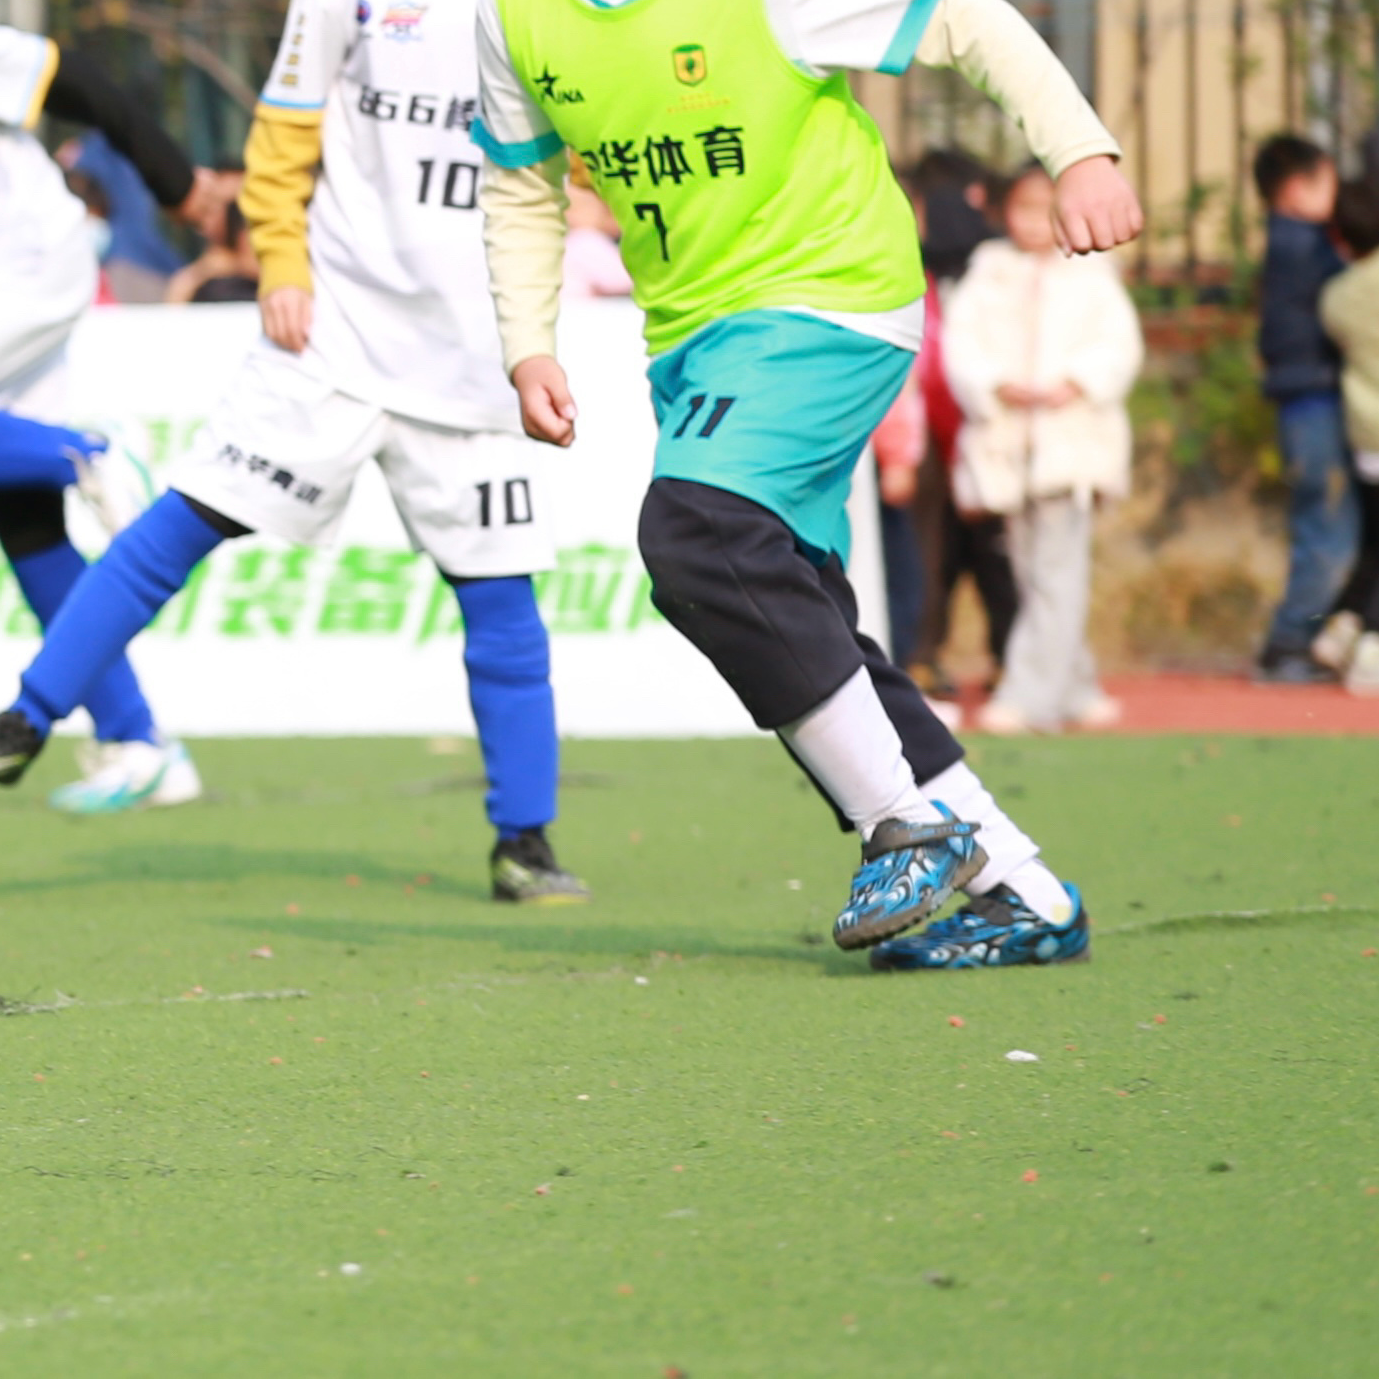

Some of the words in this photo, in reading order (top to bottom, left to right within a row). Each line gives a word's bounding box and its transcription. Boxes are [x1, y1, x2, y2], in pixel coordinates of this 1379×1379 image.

[418, 159, 480, 210] 10
[634, 203, 670, 262] 7
[672, 394, 736, 440] 11
[475, 478, 533, 528] 10
